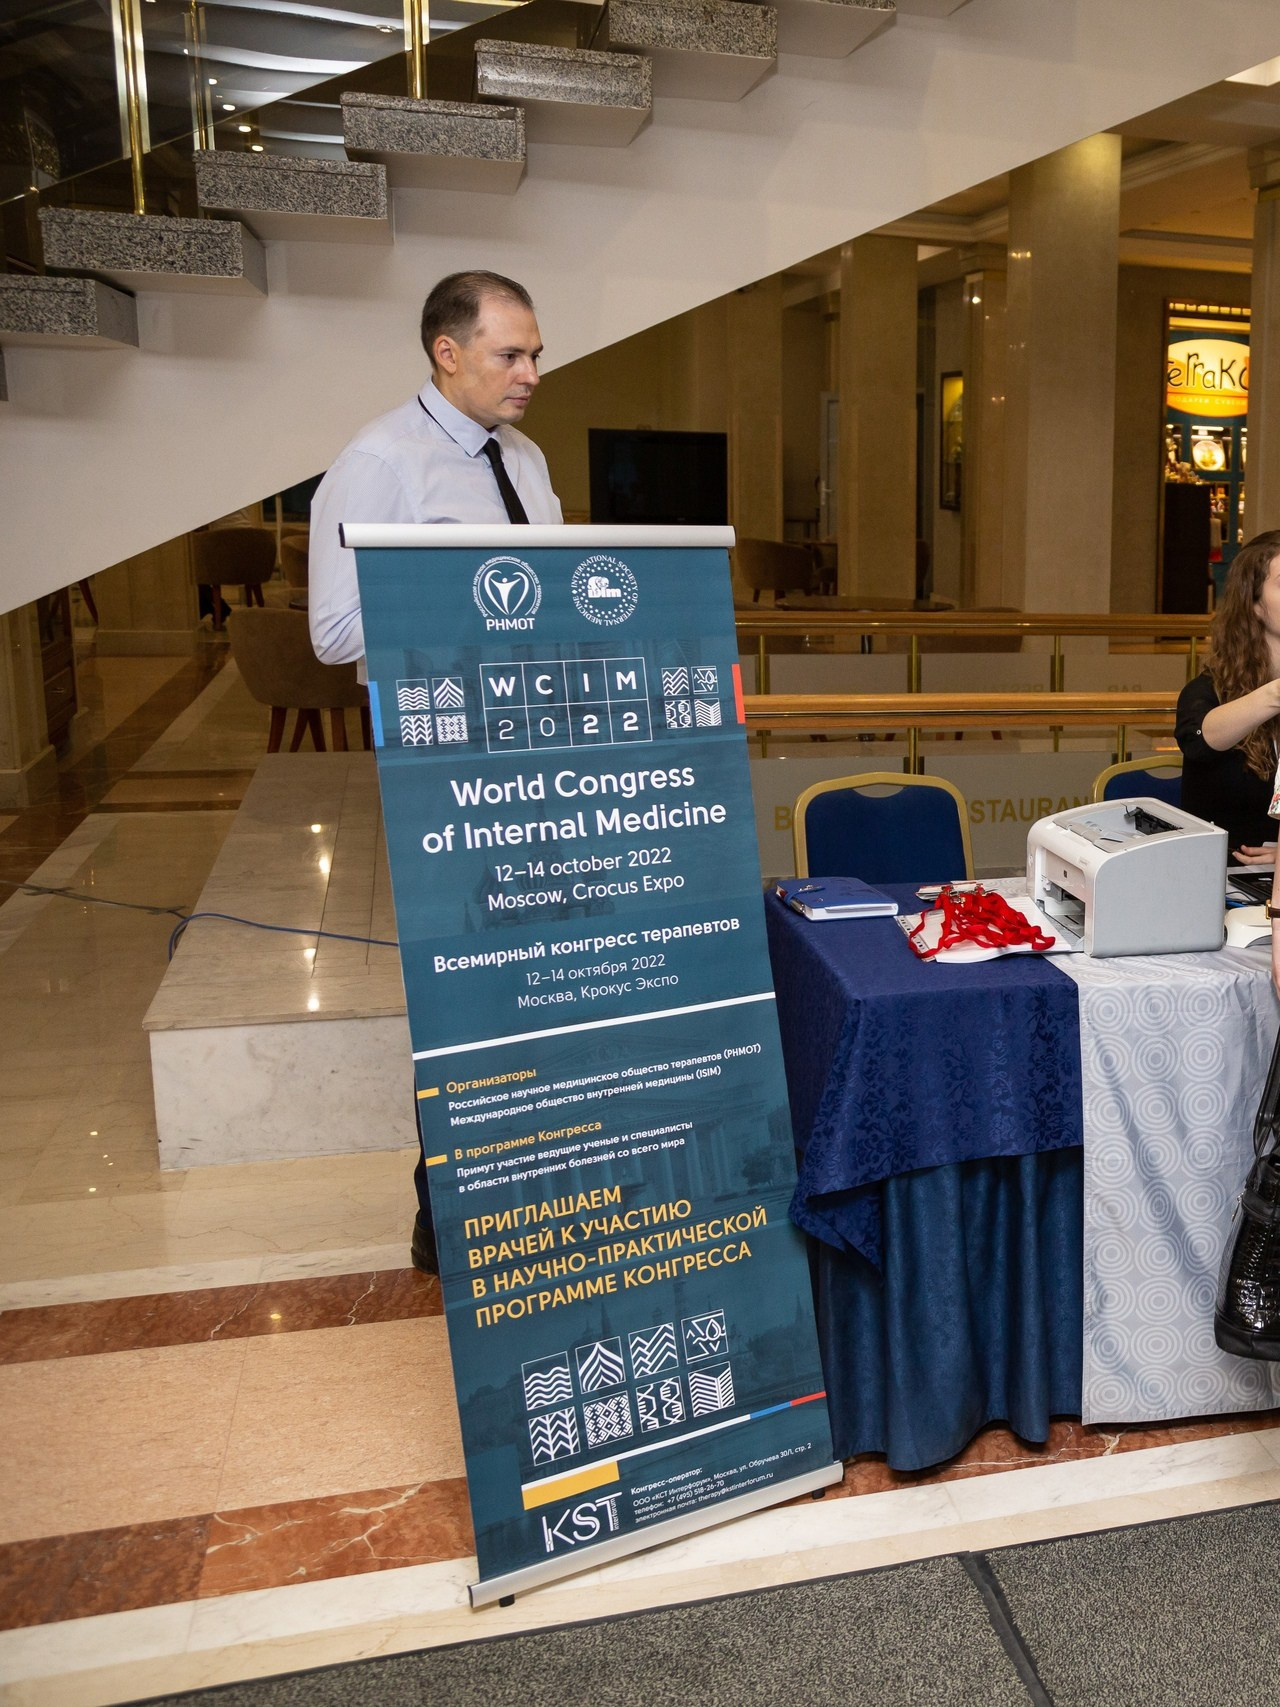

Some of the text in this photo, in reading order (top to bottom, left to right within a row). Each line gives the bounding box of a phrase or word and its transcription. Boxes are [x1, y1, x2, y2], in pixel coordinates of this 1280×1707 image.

[571, 554, 617, 588] INTERNATIONAL
[617, 560, 639, 591] SOCIETY
[486, 617, 536, 631] РНМОТ
[572, 595, 603, 626] MEDICINE
[604, 603, 636, 627] INTERNAL
[450, 767, 694, 806] World Congress
[423, 802, 726, 853] of Internal Medicine
[550, 856, 622, 875] october
[628, 847, 671, 867] 2022
[488, 876, 684, 910] Moscow, Crocus Expo
[434, 919, 739, 972] Всемирный конгресс терапевтов
[569, 962, 627, 979] октября
[632, 954, 665, 970] 2022
[518, 975, 678, 1008] Москва, Крокус Экспо
[446, 1069, 536, 1093] Организаторы
[448, 1042, 762, 1111] Российское научное медицинское общество терапевтов (РНМОТ)
[450, 1064, 722, 1127] Международное общество внутренней медицины (ISIM)
[454, 1121, 602, 1160] В программе Конгресса
[456, 1121, 693, 1179] Примут участие ведущие ученые и специалисты
[458, 1138, 686, 1193] в области внутренних болезней со всего мира
[465, 1186, 621, 1238] ПРИГЛАШАЕМ
[469, 1200, 691, 1268] ВРАЧЕЙ К УЧАСТИЮ
[472, 1205, 766, 1298] В НАУЧНО-ПРАКТИЧЕСКОЙ
[476, 1241, 751, 1328] ПРОГРАММЕ КОНГРЕССА
[631, 1467, 703, 1495] Конгресс-оператор:
[667, 1496, 675, 1504] +7
[675, 1490, 694, 1502] (495)
[693, 1479, 725, 1496] 518-26-70
[632, 1496, 651, 1507] ООО
[541, 1491, 623, 1553] KST
